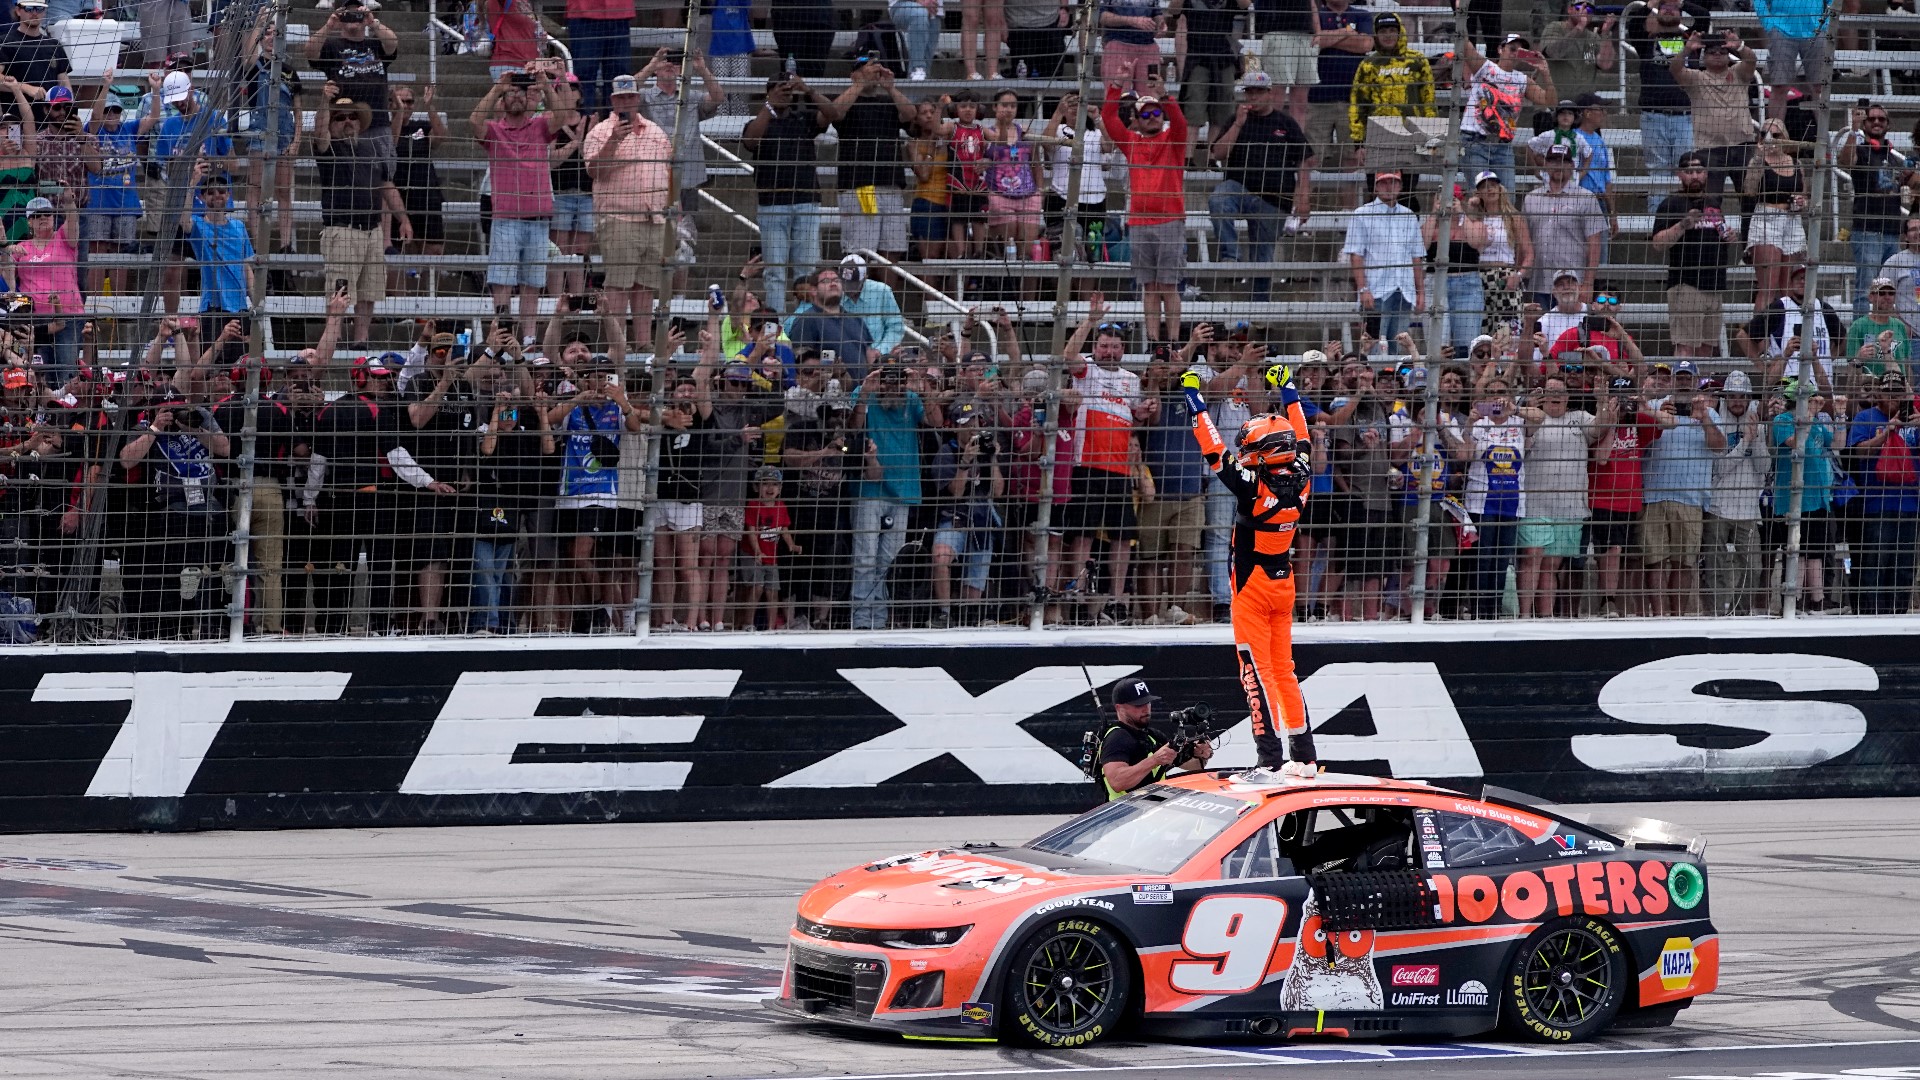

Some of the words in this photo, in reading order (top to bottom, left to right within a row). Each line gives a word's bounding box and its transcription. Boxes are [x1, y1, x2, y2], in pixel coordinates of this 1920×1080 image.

[1413, 455, 1441, 470] NA
[31, 653, 1880, 797] TEXAS
[1174, 797, 1235, 814] ELLIOTT
[1455, 803, 1487, 817] Kelley
[1488, 810, 1512, 821] Blue
[1513, 815, 1540, 829] Book
[1036, 896, 1115, 915] GOODYEAR
[1057, 919, 1101, 936] EAGLE
[1585, 920, 1620, 954] EAGLE
[1170, 893, 1288, 995] 9
[1663, 951, 1692, 976] NAPA
[1391, 992, 1441, 1005] UniFirst
[1513, 975, 1572, 1041] GOODYEAR
[1018, 1012, 1103, 1047] GOODYEAR
